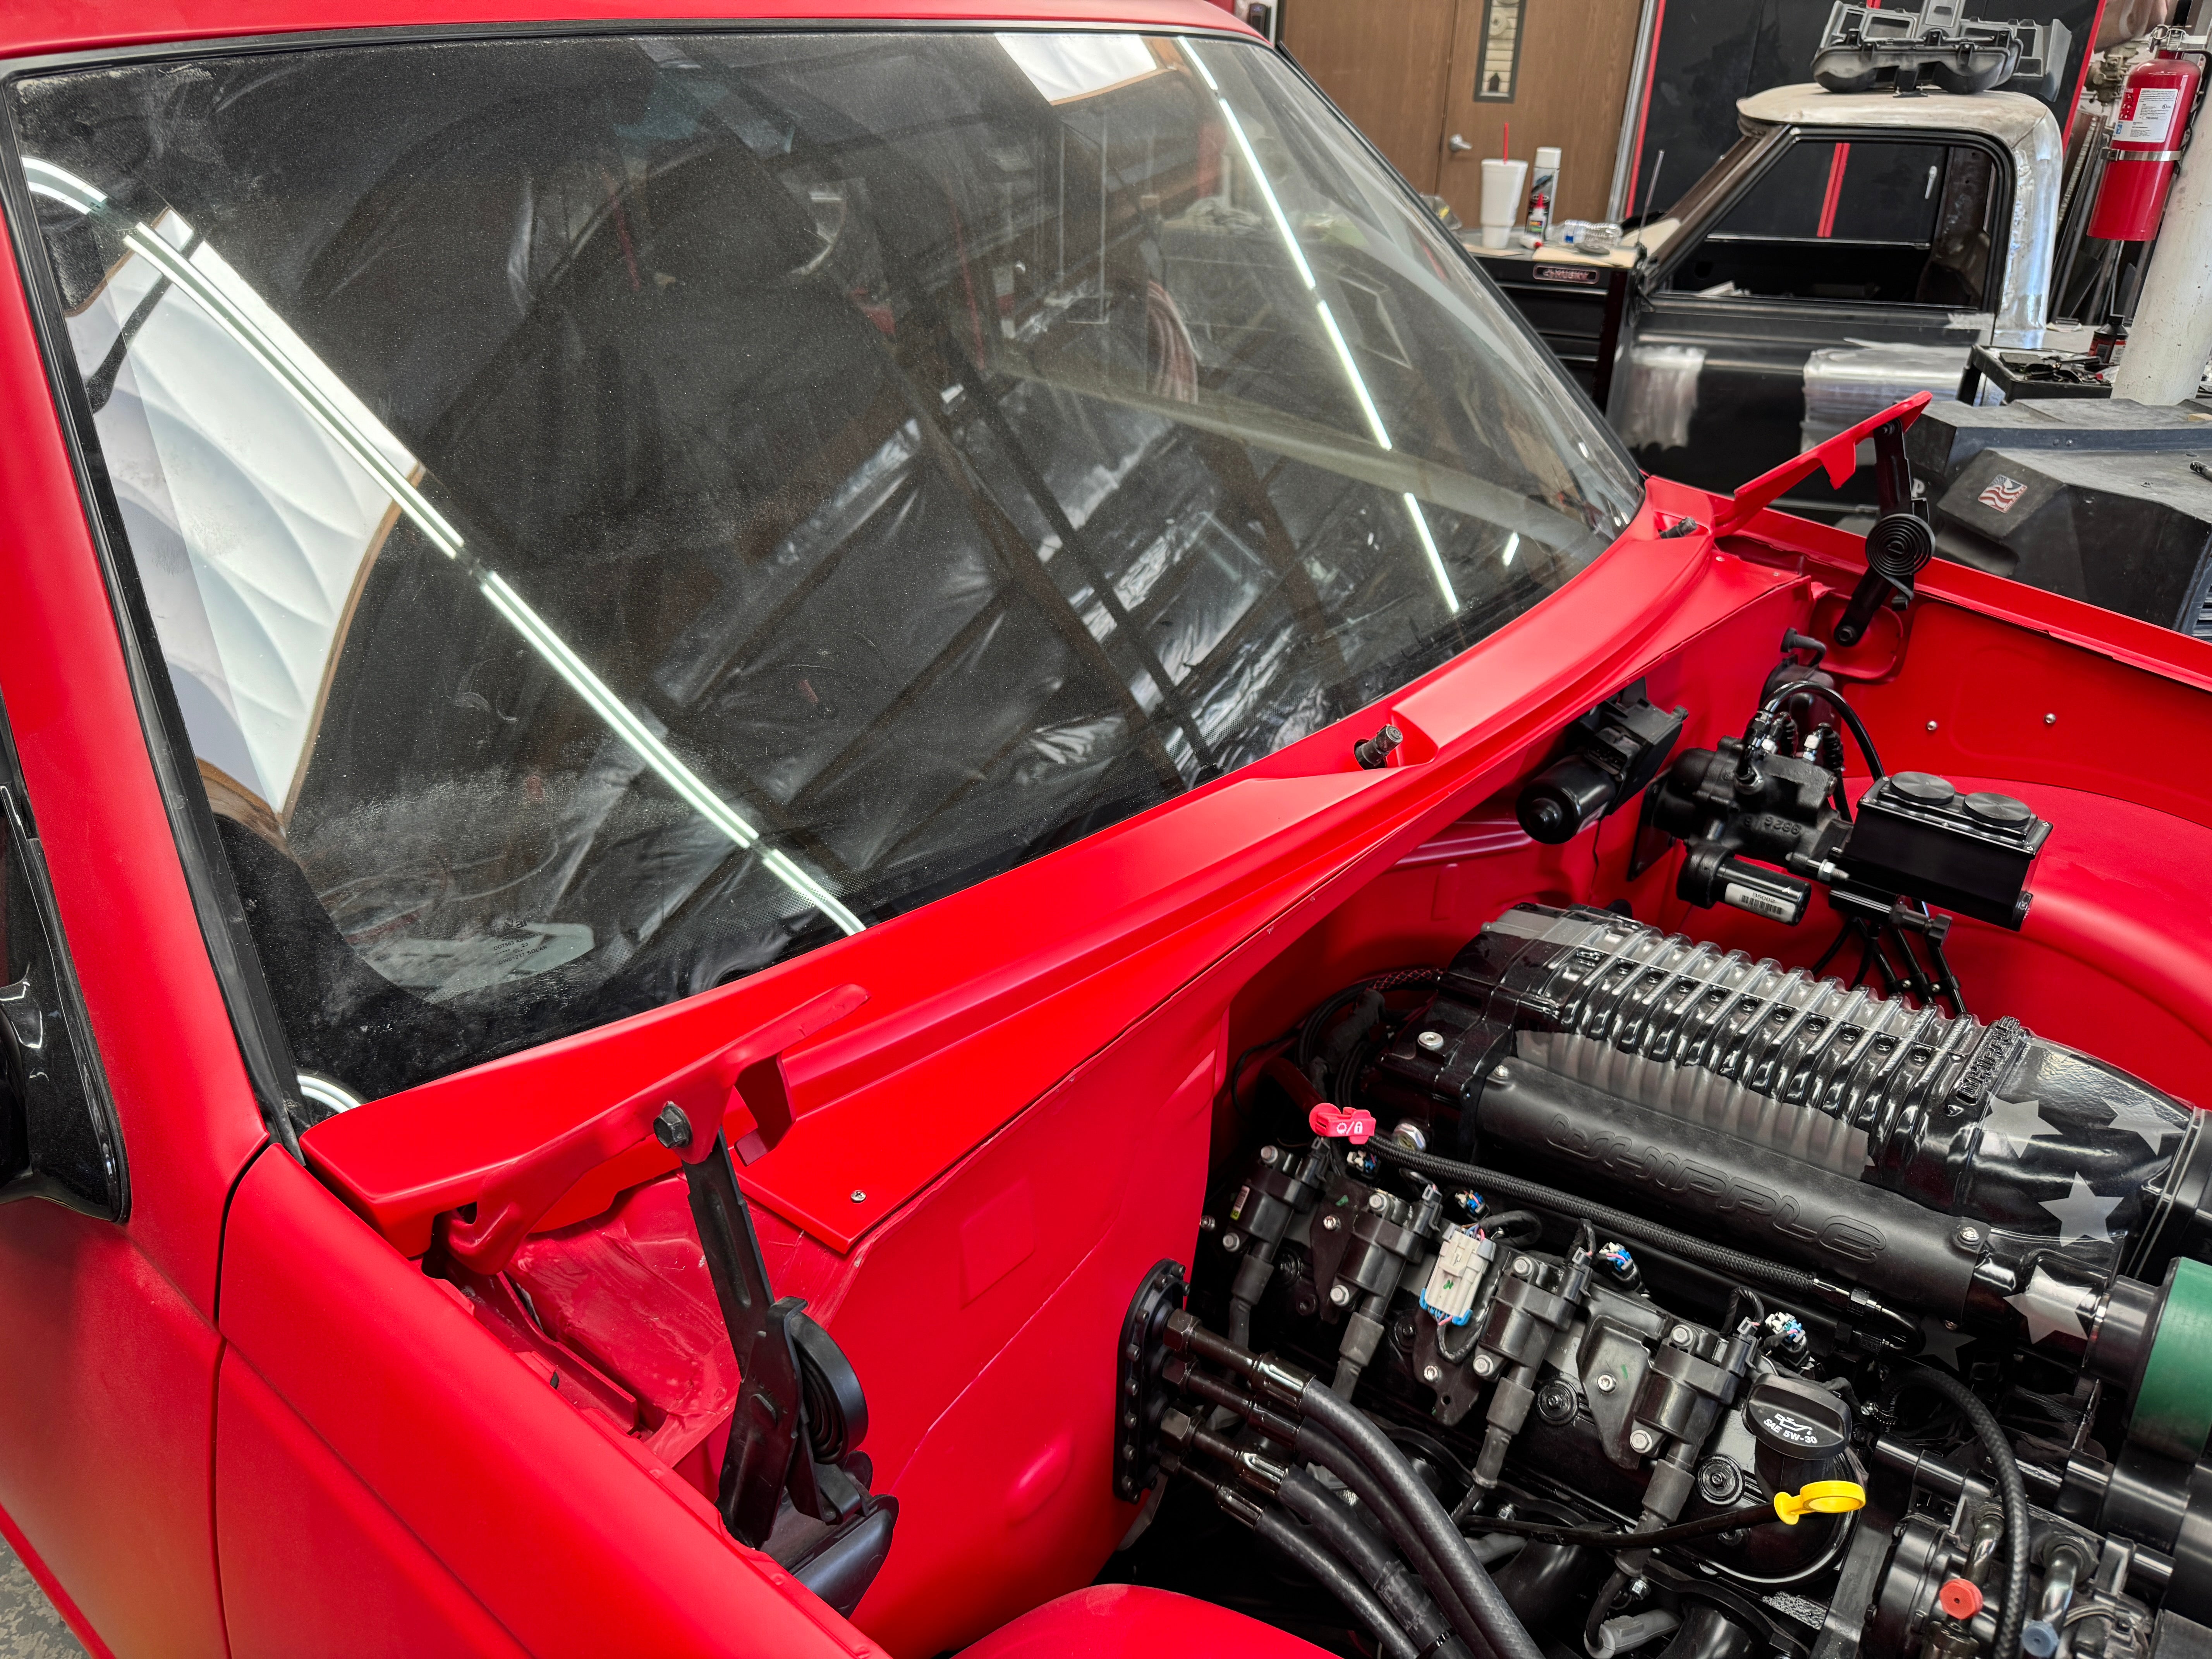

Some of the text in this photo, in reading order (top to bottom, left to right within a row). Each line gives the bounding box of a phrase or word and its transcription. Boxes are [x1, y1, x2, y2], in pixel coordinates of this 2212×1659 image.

[527, 945, 548, 955] SOLAR
[1546, 1114, 1886, 1263] WHIPPLE
[1764, 1419, 1817, 1444] SAE 5W-30
